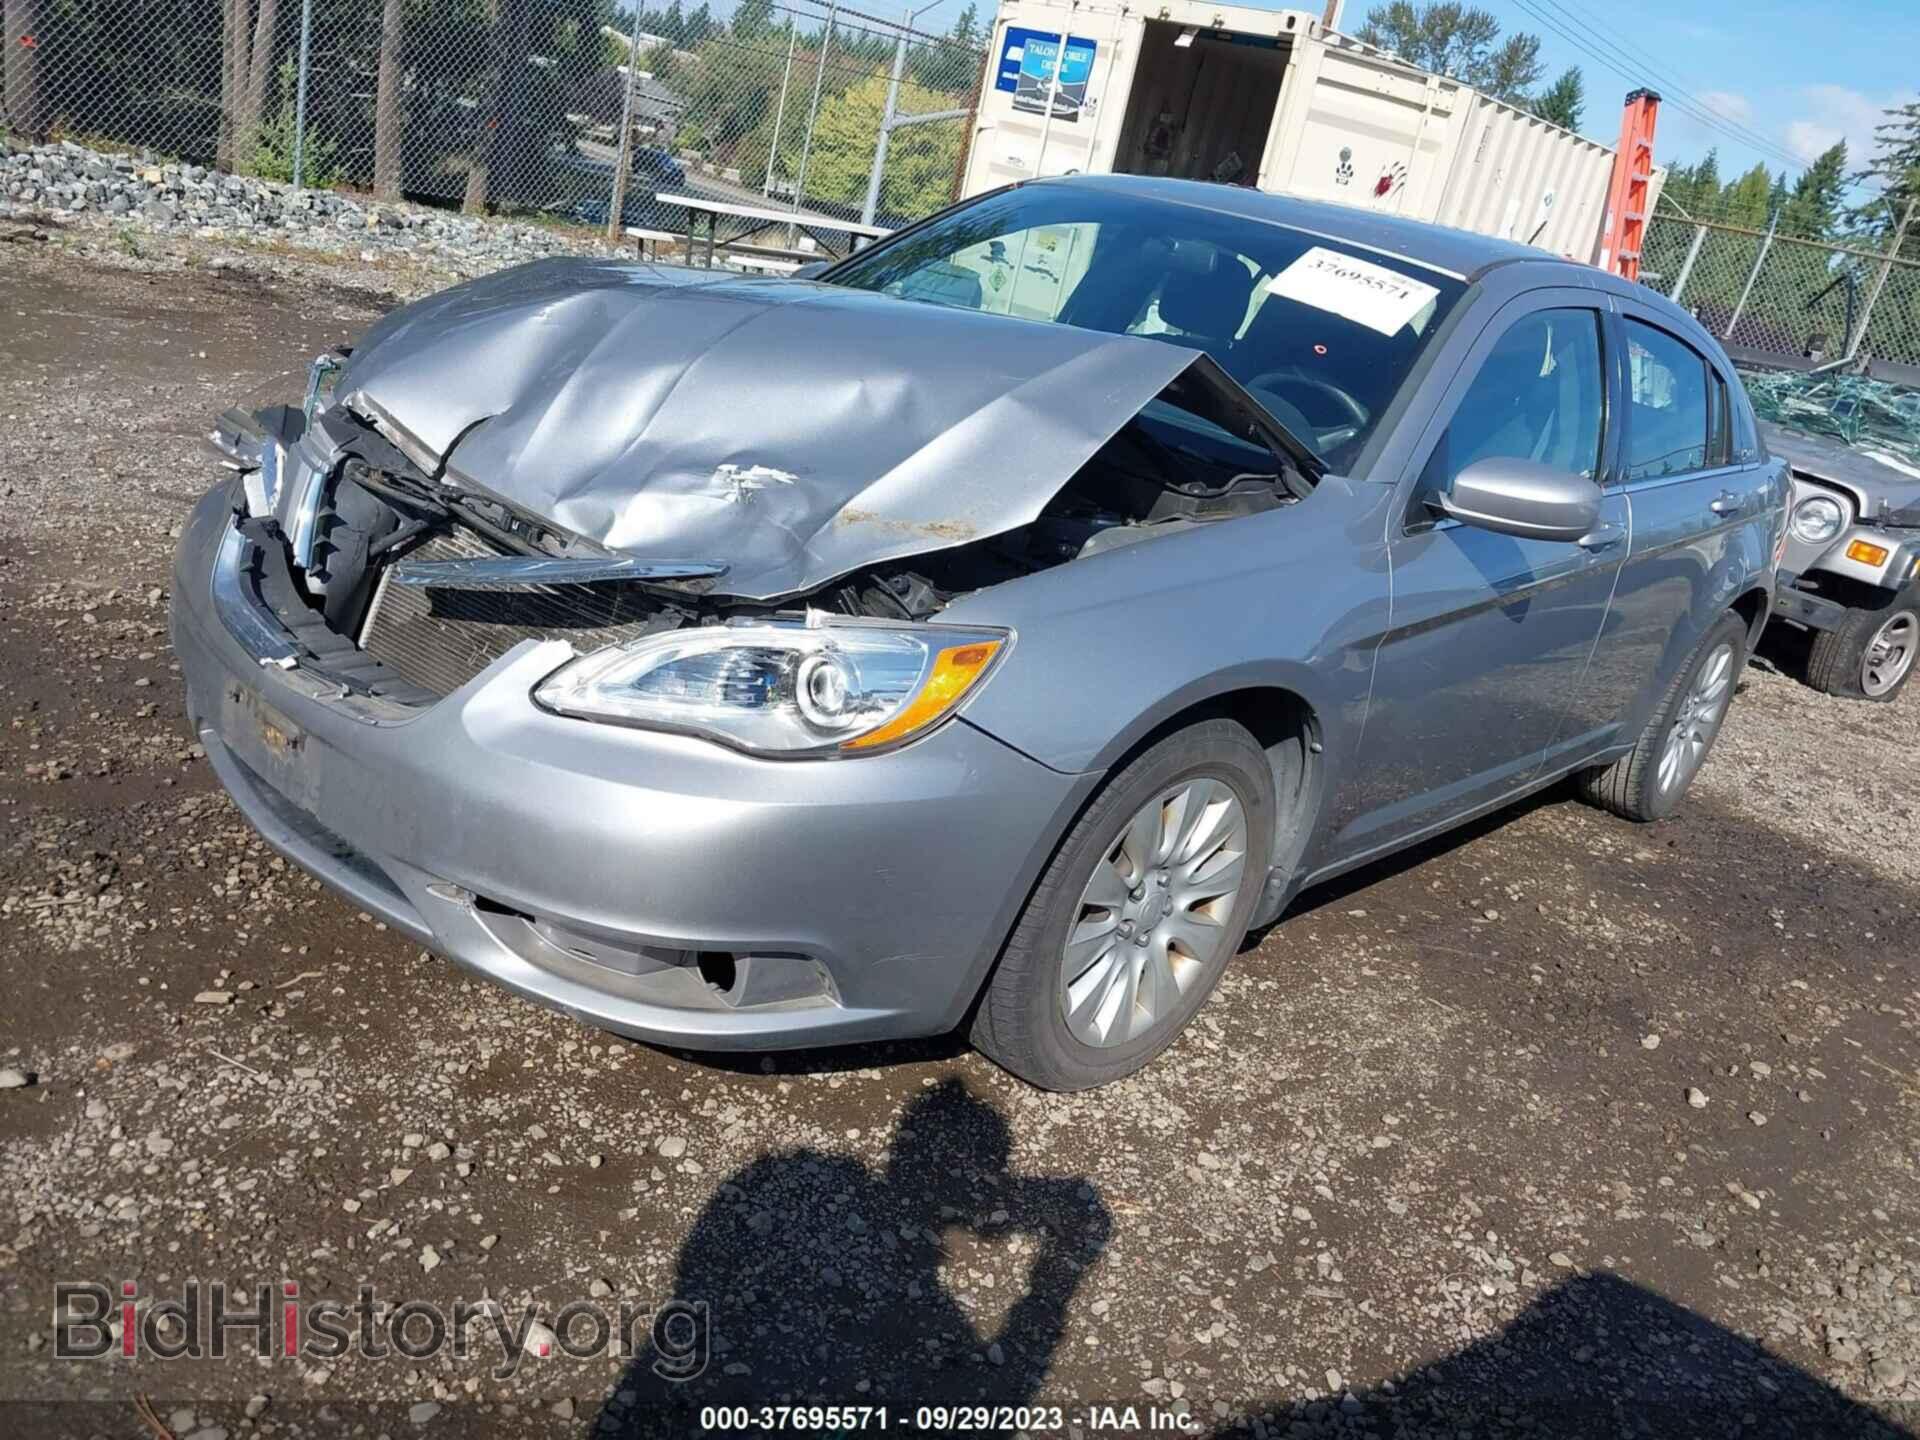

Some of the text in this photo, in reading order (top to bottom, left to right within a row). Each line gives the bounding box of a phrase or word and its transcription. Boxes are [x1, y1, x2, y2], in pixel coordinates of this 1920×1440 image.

[1029, 43, 1088, 63] TALON OBILE
[1307, 258, 1409, 300] 37695571
